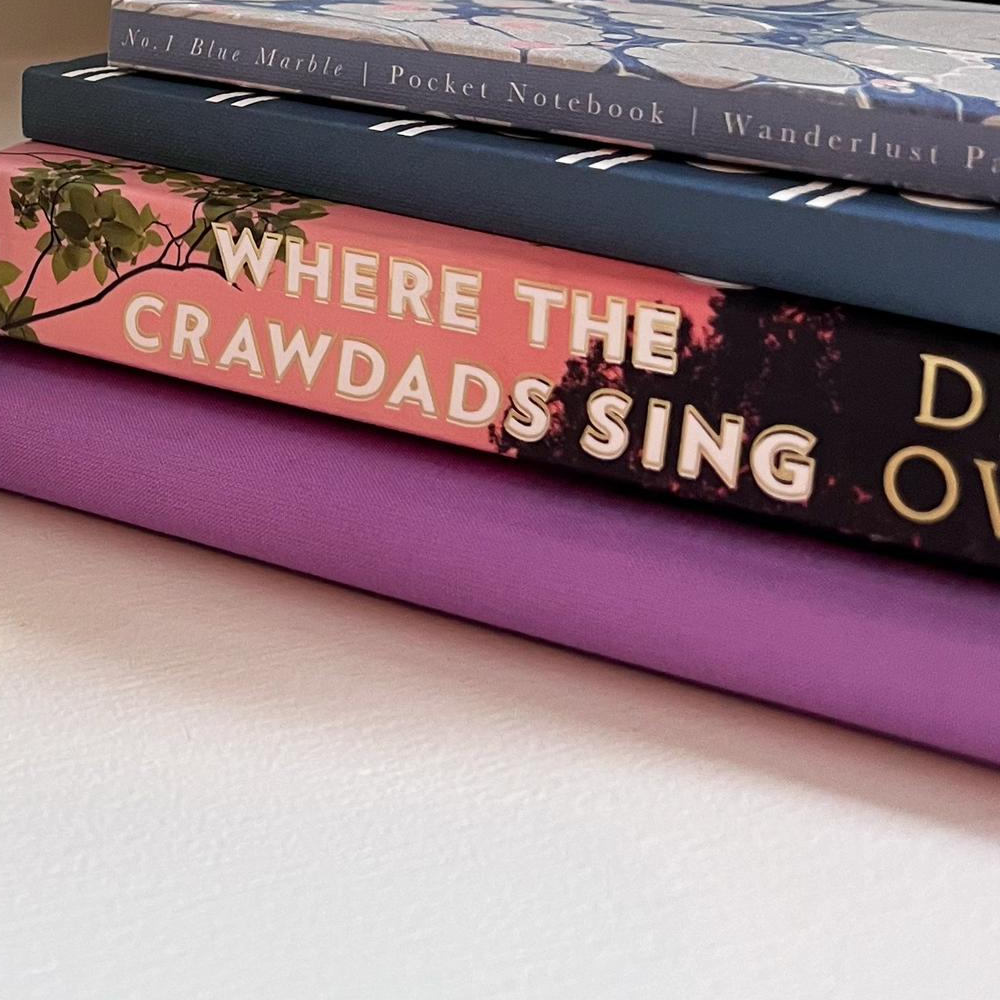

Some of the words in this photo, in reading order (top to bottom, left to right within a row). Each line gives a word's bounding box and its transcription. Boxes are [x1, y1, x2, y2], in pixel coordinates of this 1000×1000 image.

[121, 28, 174, 53] No.1
[190, 38, 241, 62] Blue
[255, 46, 344, 77] Marble
[389, 65, 488, 99] Pocket
[509, 82, 665, 125] Notebook
[724, 112, 939, 166] Wanderlust
[212, 222, 482, 334] WHERE
[514, 279, 681, 375] THE
[123, 292, 555, 443] CRAWDADS
[579, 388, 818, 501] SING
